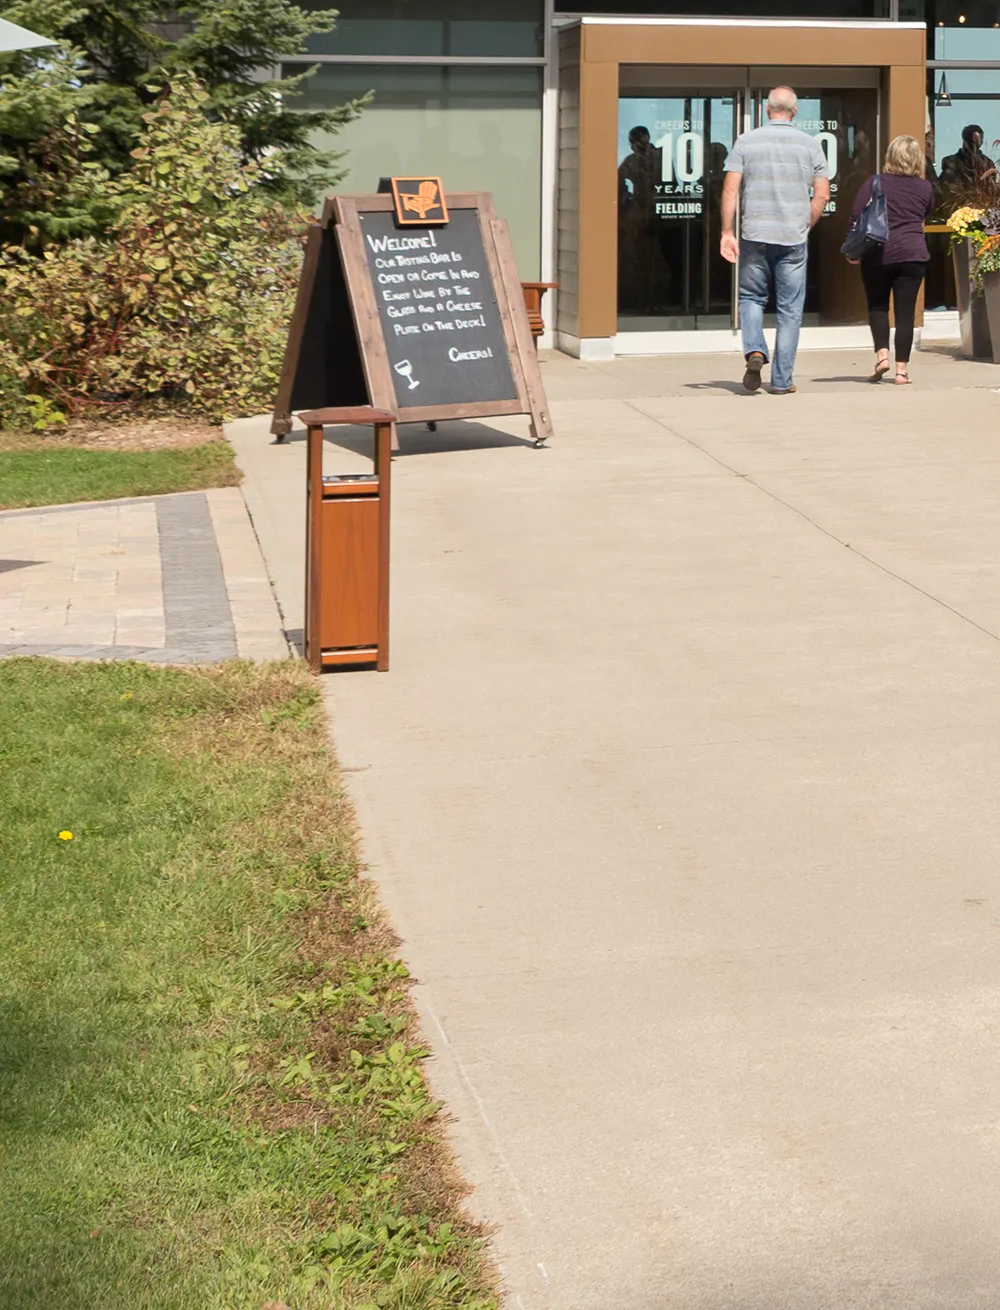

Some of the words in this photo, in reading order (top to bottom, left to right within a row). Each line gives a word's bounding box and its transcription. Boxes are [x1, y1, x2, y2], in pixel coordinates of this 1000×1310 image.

[692, 120, 704, 130] TO
[826, 120, 838, 130] TO
[655, 131, 704, 182] 10
[654, 185, 704, 194] YEARS
[655, 202, 702, 214] FIELDING
[366, 230, 437, 253] WELCOME!
[375, 258, 396, 269] OUR
[429, 252, 450, 264] BAR
[377, 273, 405, 284] OPEN
[421, 269, 449, 281] COME
[460, 269, 480, 279] AND
[412, 289, 436, 299] WINE
[438, 287, 452, 297] BY
[453, 285, 471, 296] THE
[446, 300, 483, 312] CHEESE
[393, 324, 421, 336] PLATE
[434, 321, 455, 331] THE
[448, 347, 493, 362] CHEERS!
